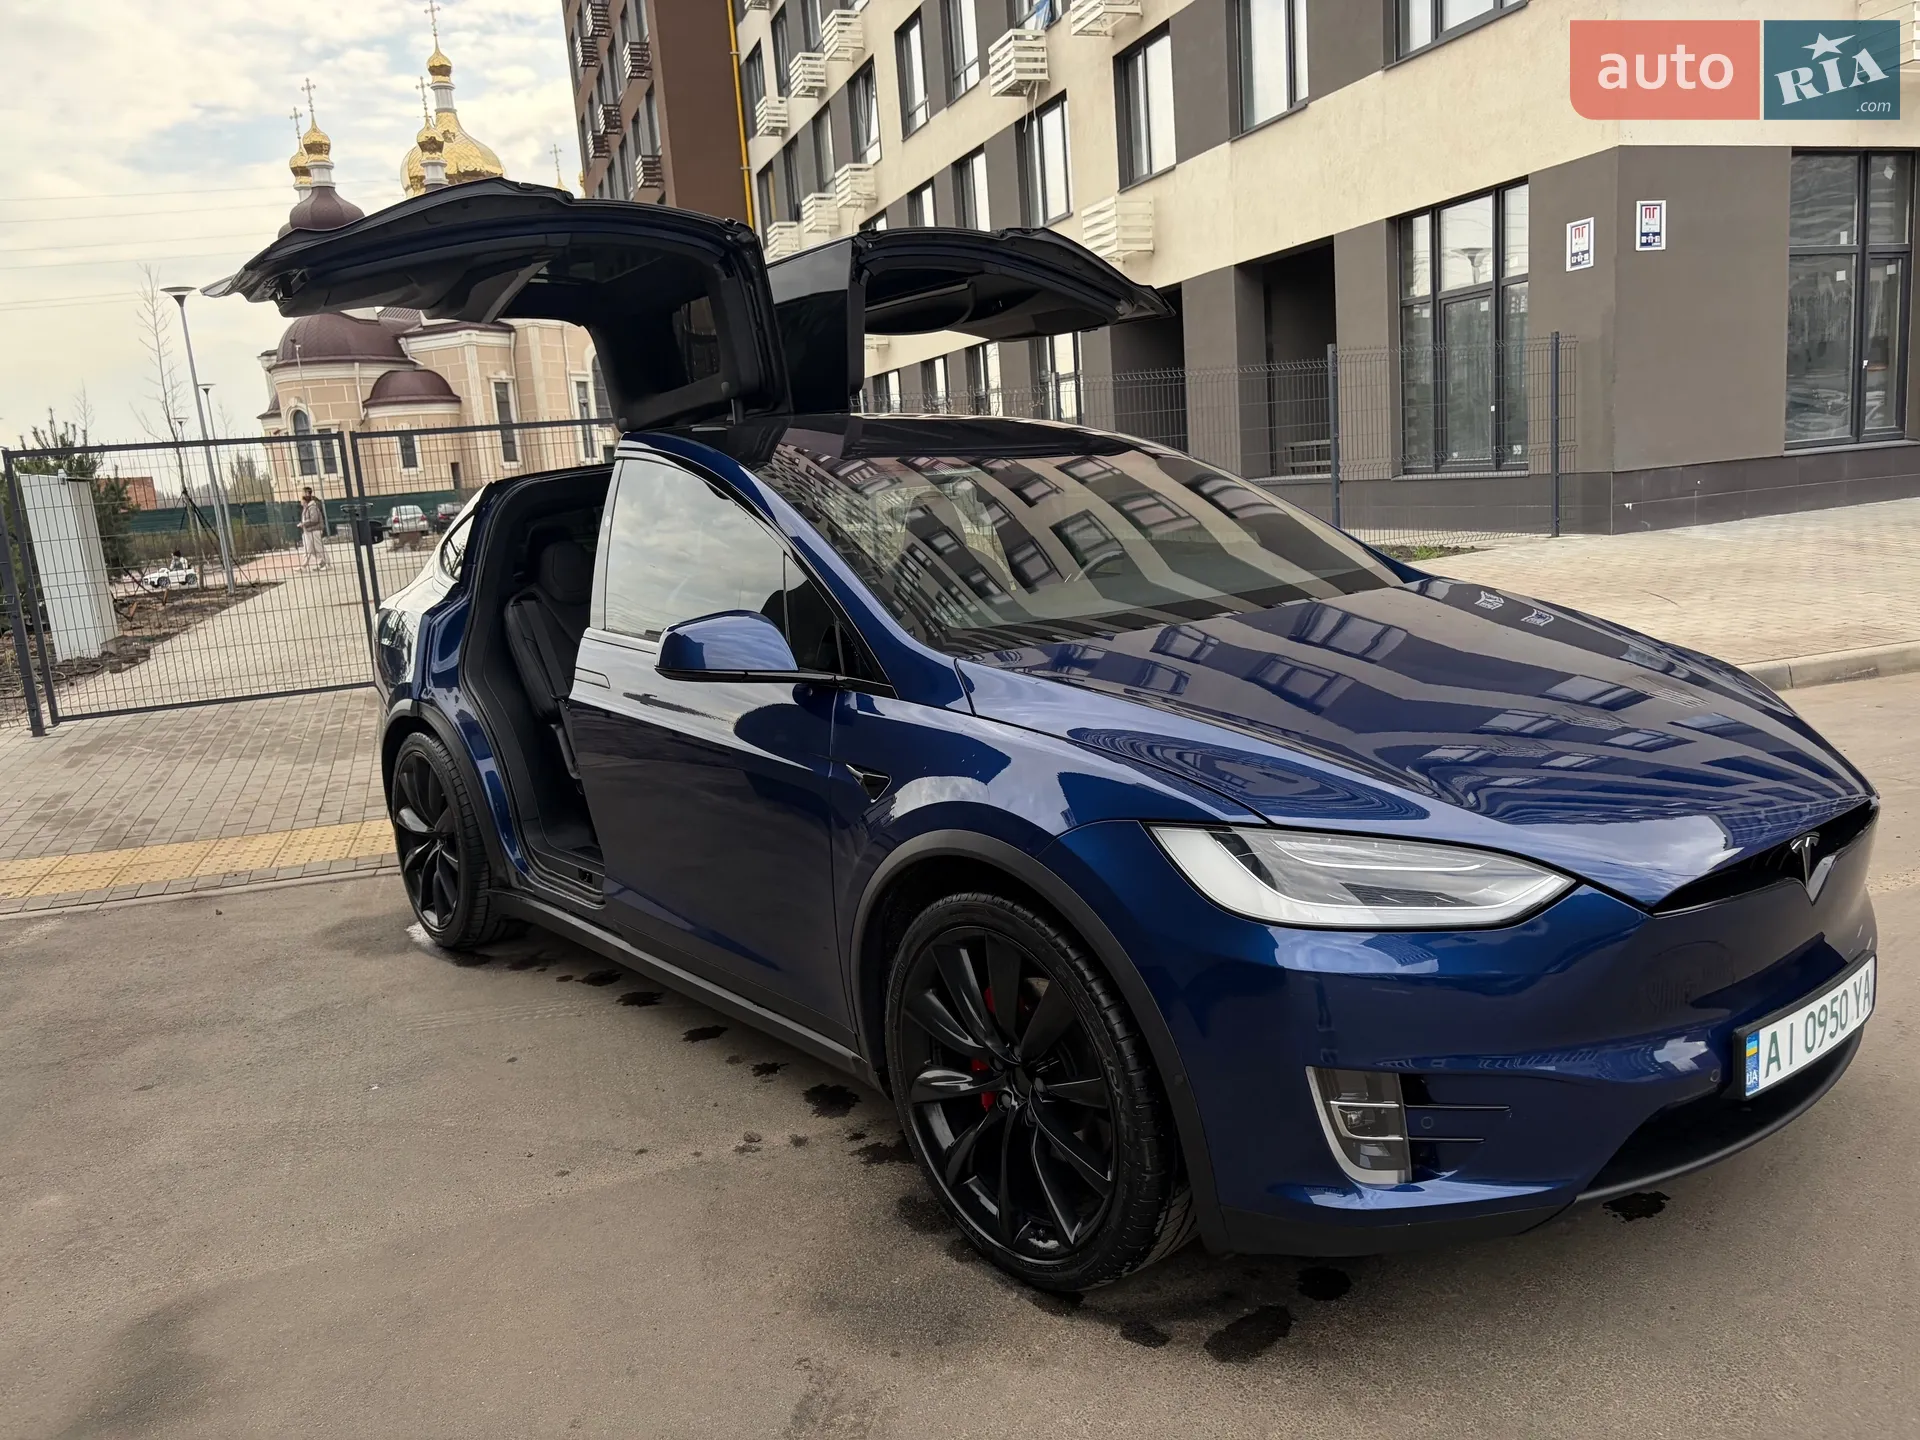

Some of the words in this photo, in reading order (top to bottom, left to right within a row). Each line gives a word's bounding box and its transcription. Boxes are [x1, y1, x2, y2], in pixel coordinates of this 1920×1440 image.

[1764, 1022, 1794, 1078] AI
[1804, 989, 1849, 1054] 0950
[1853, 969, 1871, 1019] YA
[1746, 1070, 1758, 1085] UA
